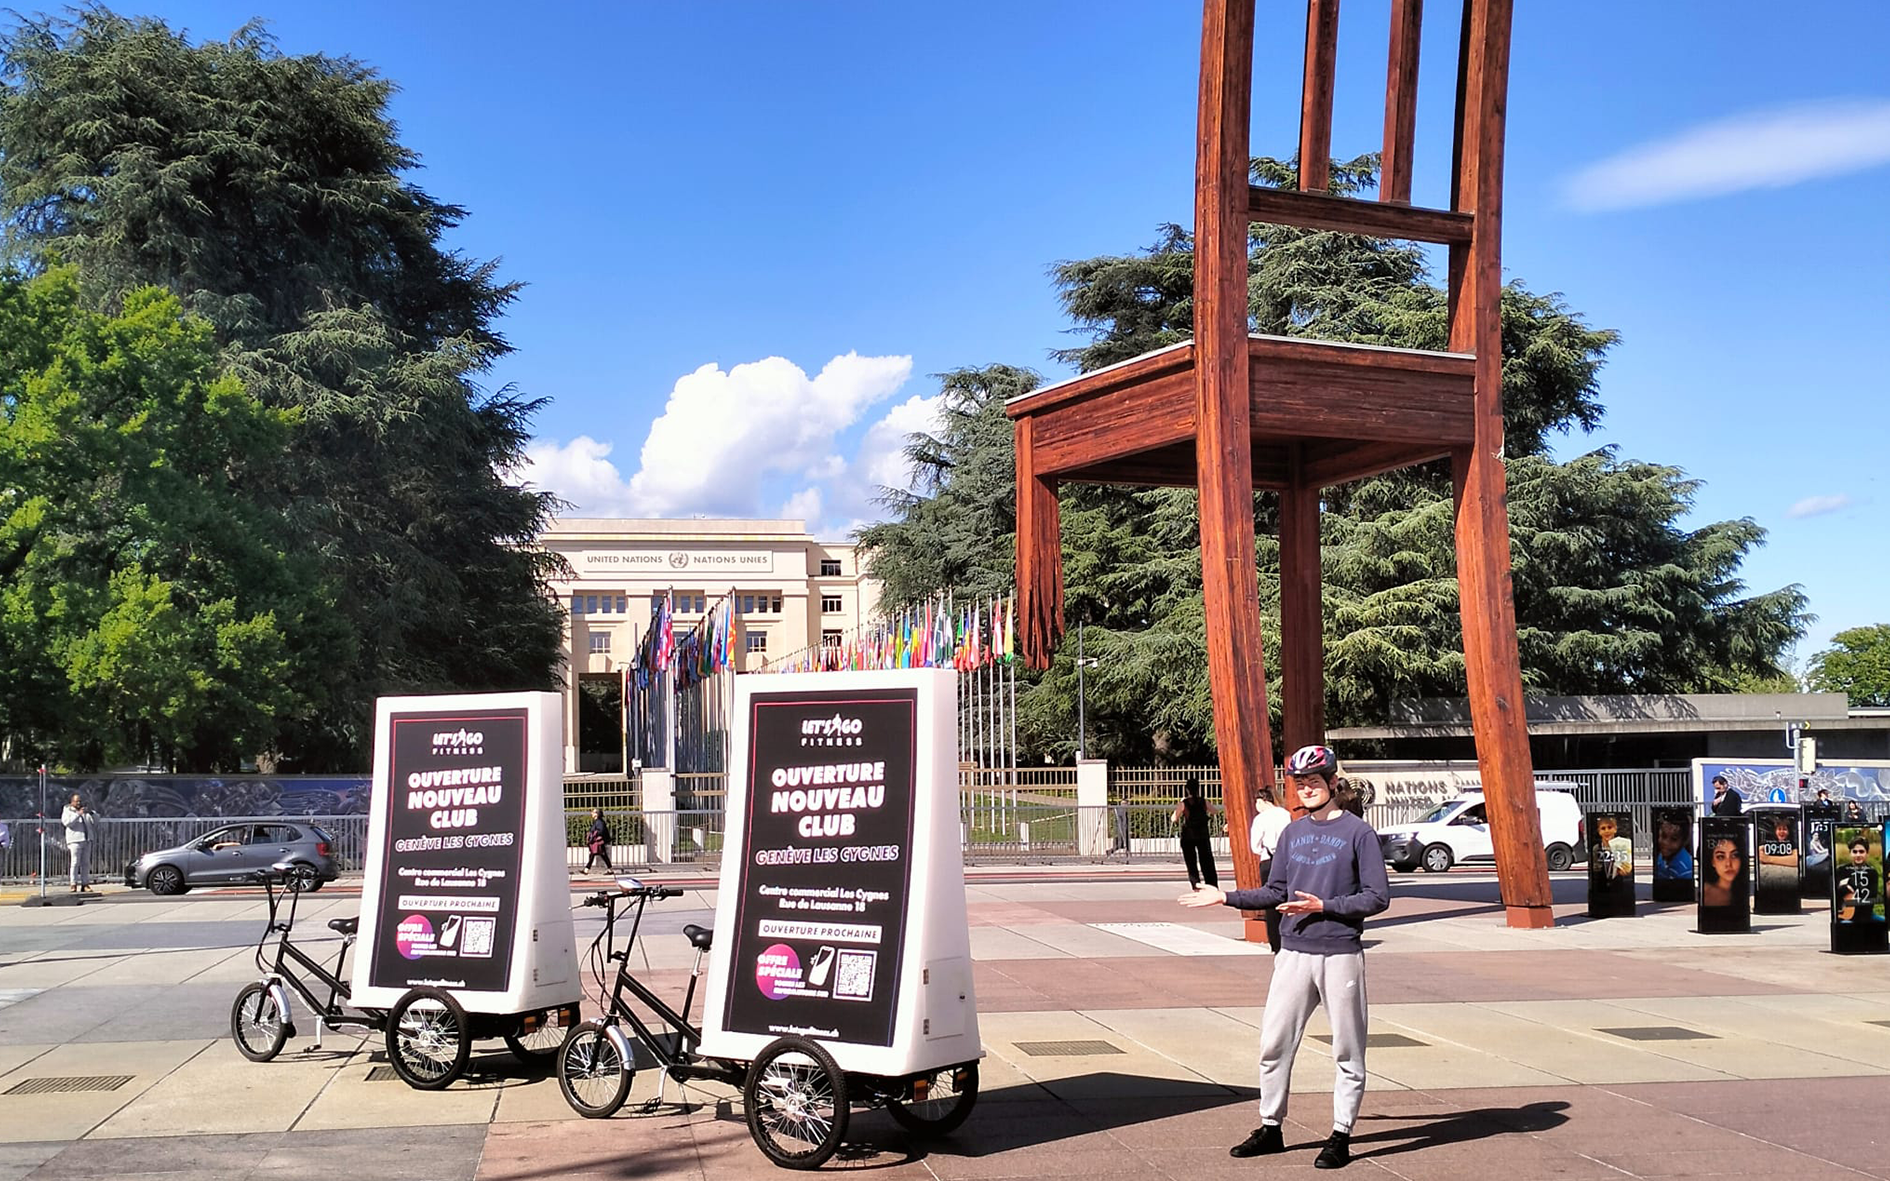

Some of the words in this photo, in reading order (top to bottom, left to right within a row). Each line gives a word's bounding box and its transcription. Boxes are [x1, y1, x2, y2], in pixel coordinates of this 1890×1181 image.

[587, 556, 619, 564] UNITED
[622, 556, 663, 564] NATIONS
[693, 556, 736, 564] NATIONS
[740, 556, 767, 564] UNIES
[841, 719, 862, 734] GO
[801, 738, 862, 746] FITNESS
[408, 767, 502, 788] OUVERTURE
[772, 762, 885, 787] OUVERTURE
[1385, 781, 1448, 795] NATIONS
[408, 785, 502, 809] NOUVEAU
[771, 785, 885, 813] NOUVEAU
[430, 809, 478, 829] CLUB
[799, 814, 855, 837] CLUB
[395, 835, 442, 852] GENÈVE
[443, 836, 463, 849] LES
[465, 833, 514, 848] CYGNES
[1764, 843, 1792, 855] 09:08
[756, 845, 812, 865] GENÈVE
[813, 848, 838, 863] LES
[840, 845, 899, 862] CYGNES
[1851, 870, 1869, 887] 15
[759, 885, 788, 895] Centre
[789, 886, 839, 898] commercial
[840, 888, 855, 899] Les
[856, 889, 889, 902] Cygnes
[1852, 888, 1870, 904] 42
[402, 899, 447, 908] OUVERTURE
[450, 900, 496, 909] PROCHAINE
[779, 898, 796, 909] Rue
[798, 898, 809, 909] de
[811, 899, 853, 911] Lausanne
[855, 901, 866, 912] 18
[763, 924, 819, 935] OUVERTURE
[821, 928, 877, 939] PROCHAINE
[757, 954, 788, 966] OFFRE
[757, 965, 803, 979] SPÉCIALE
